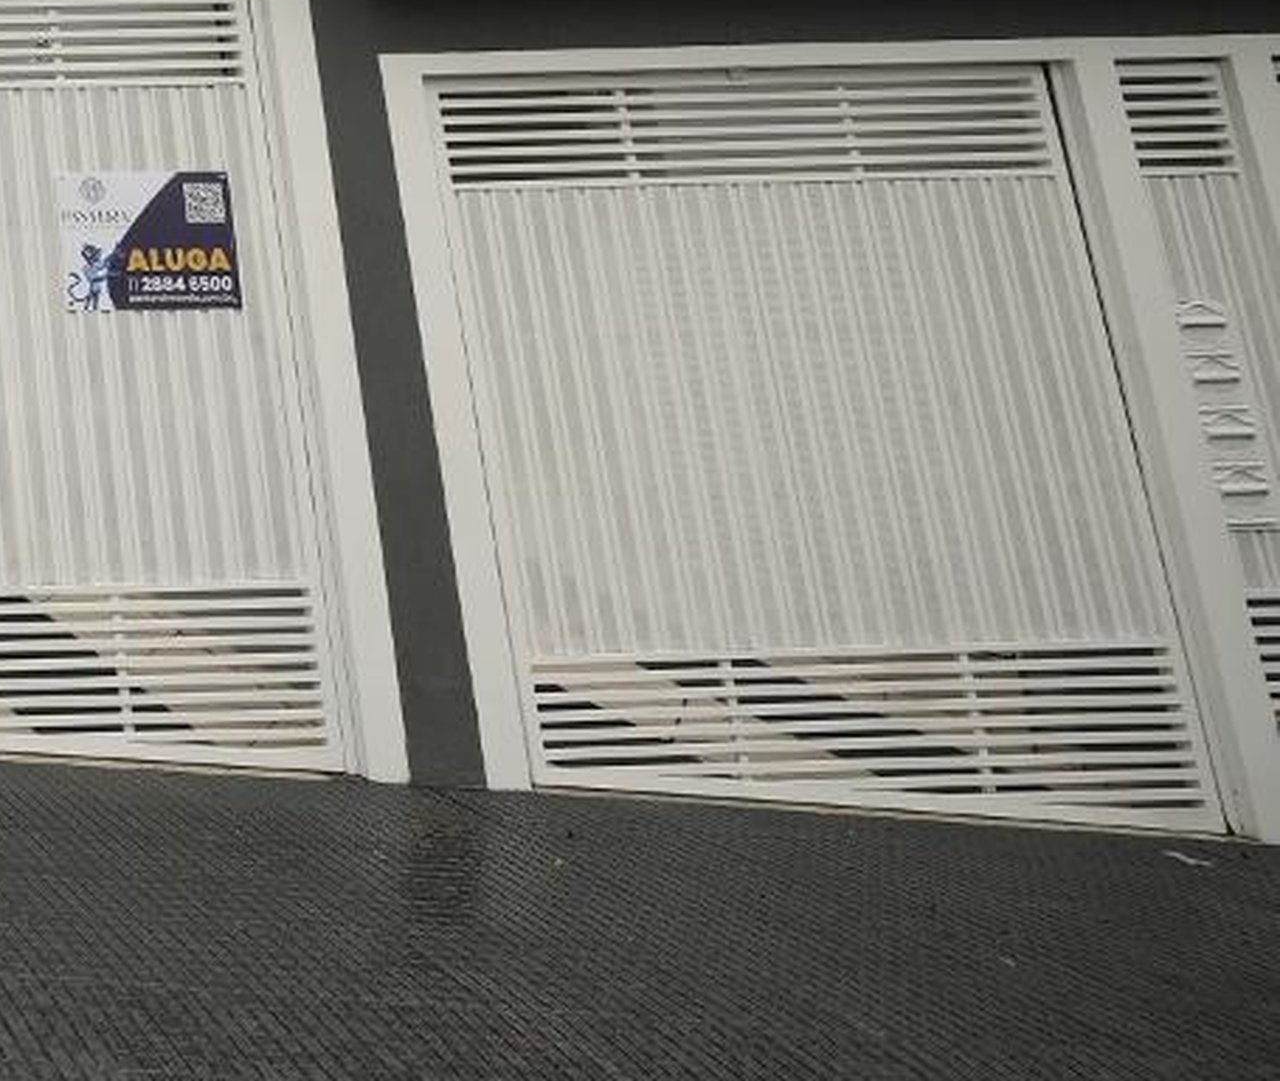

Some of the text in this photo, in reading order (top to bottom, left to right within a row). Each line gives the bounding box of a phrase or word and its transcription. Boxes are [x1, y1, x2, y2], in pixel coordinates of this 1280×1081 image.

[126, 247, 231, 271] ALUGA
[141, 275, 186, 292] 2884
[189, 275, 233, 292] 6500
